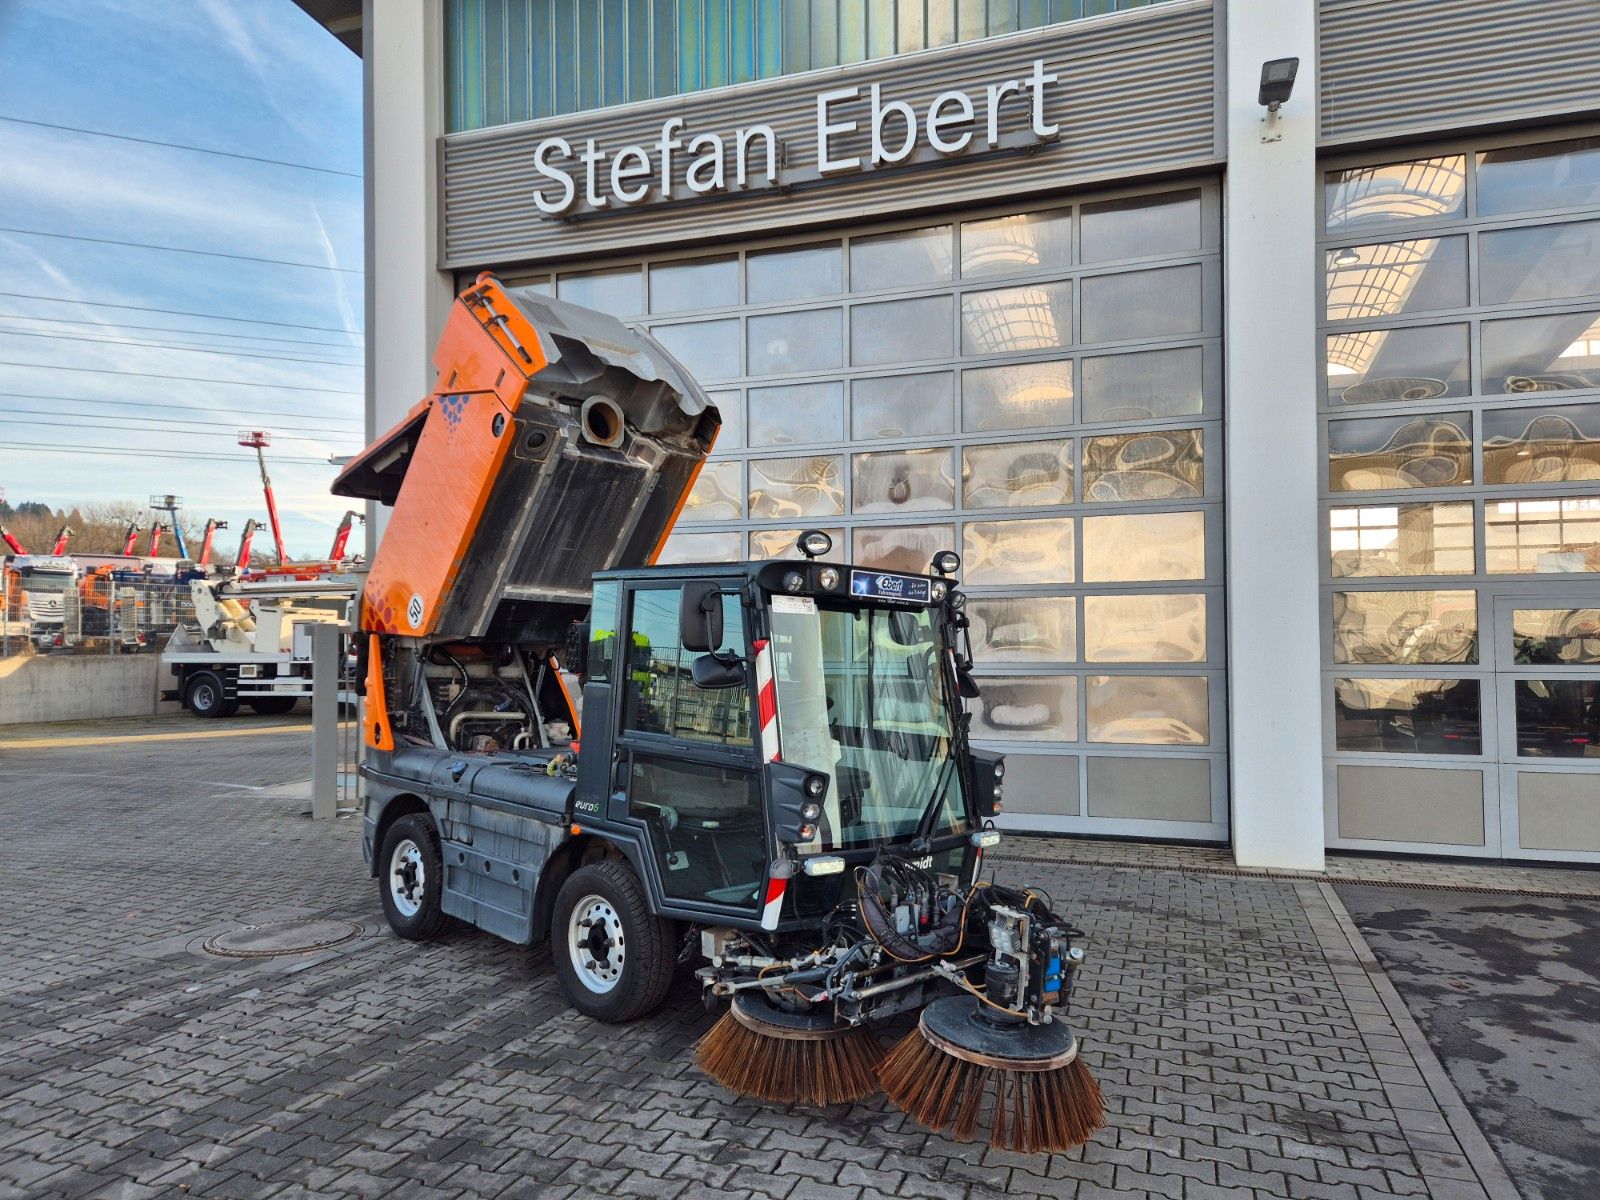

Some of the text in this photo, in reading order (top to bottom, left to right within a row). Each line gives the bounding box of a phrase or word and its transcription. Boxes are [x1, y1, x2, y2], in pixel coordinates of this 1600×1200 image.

[533, 59, 1059, 214] Stefan Ebert
[409, 598, 422, 623] 50
[575, 800, 600, 813] euro6
